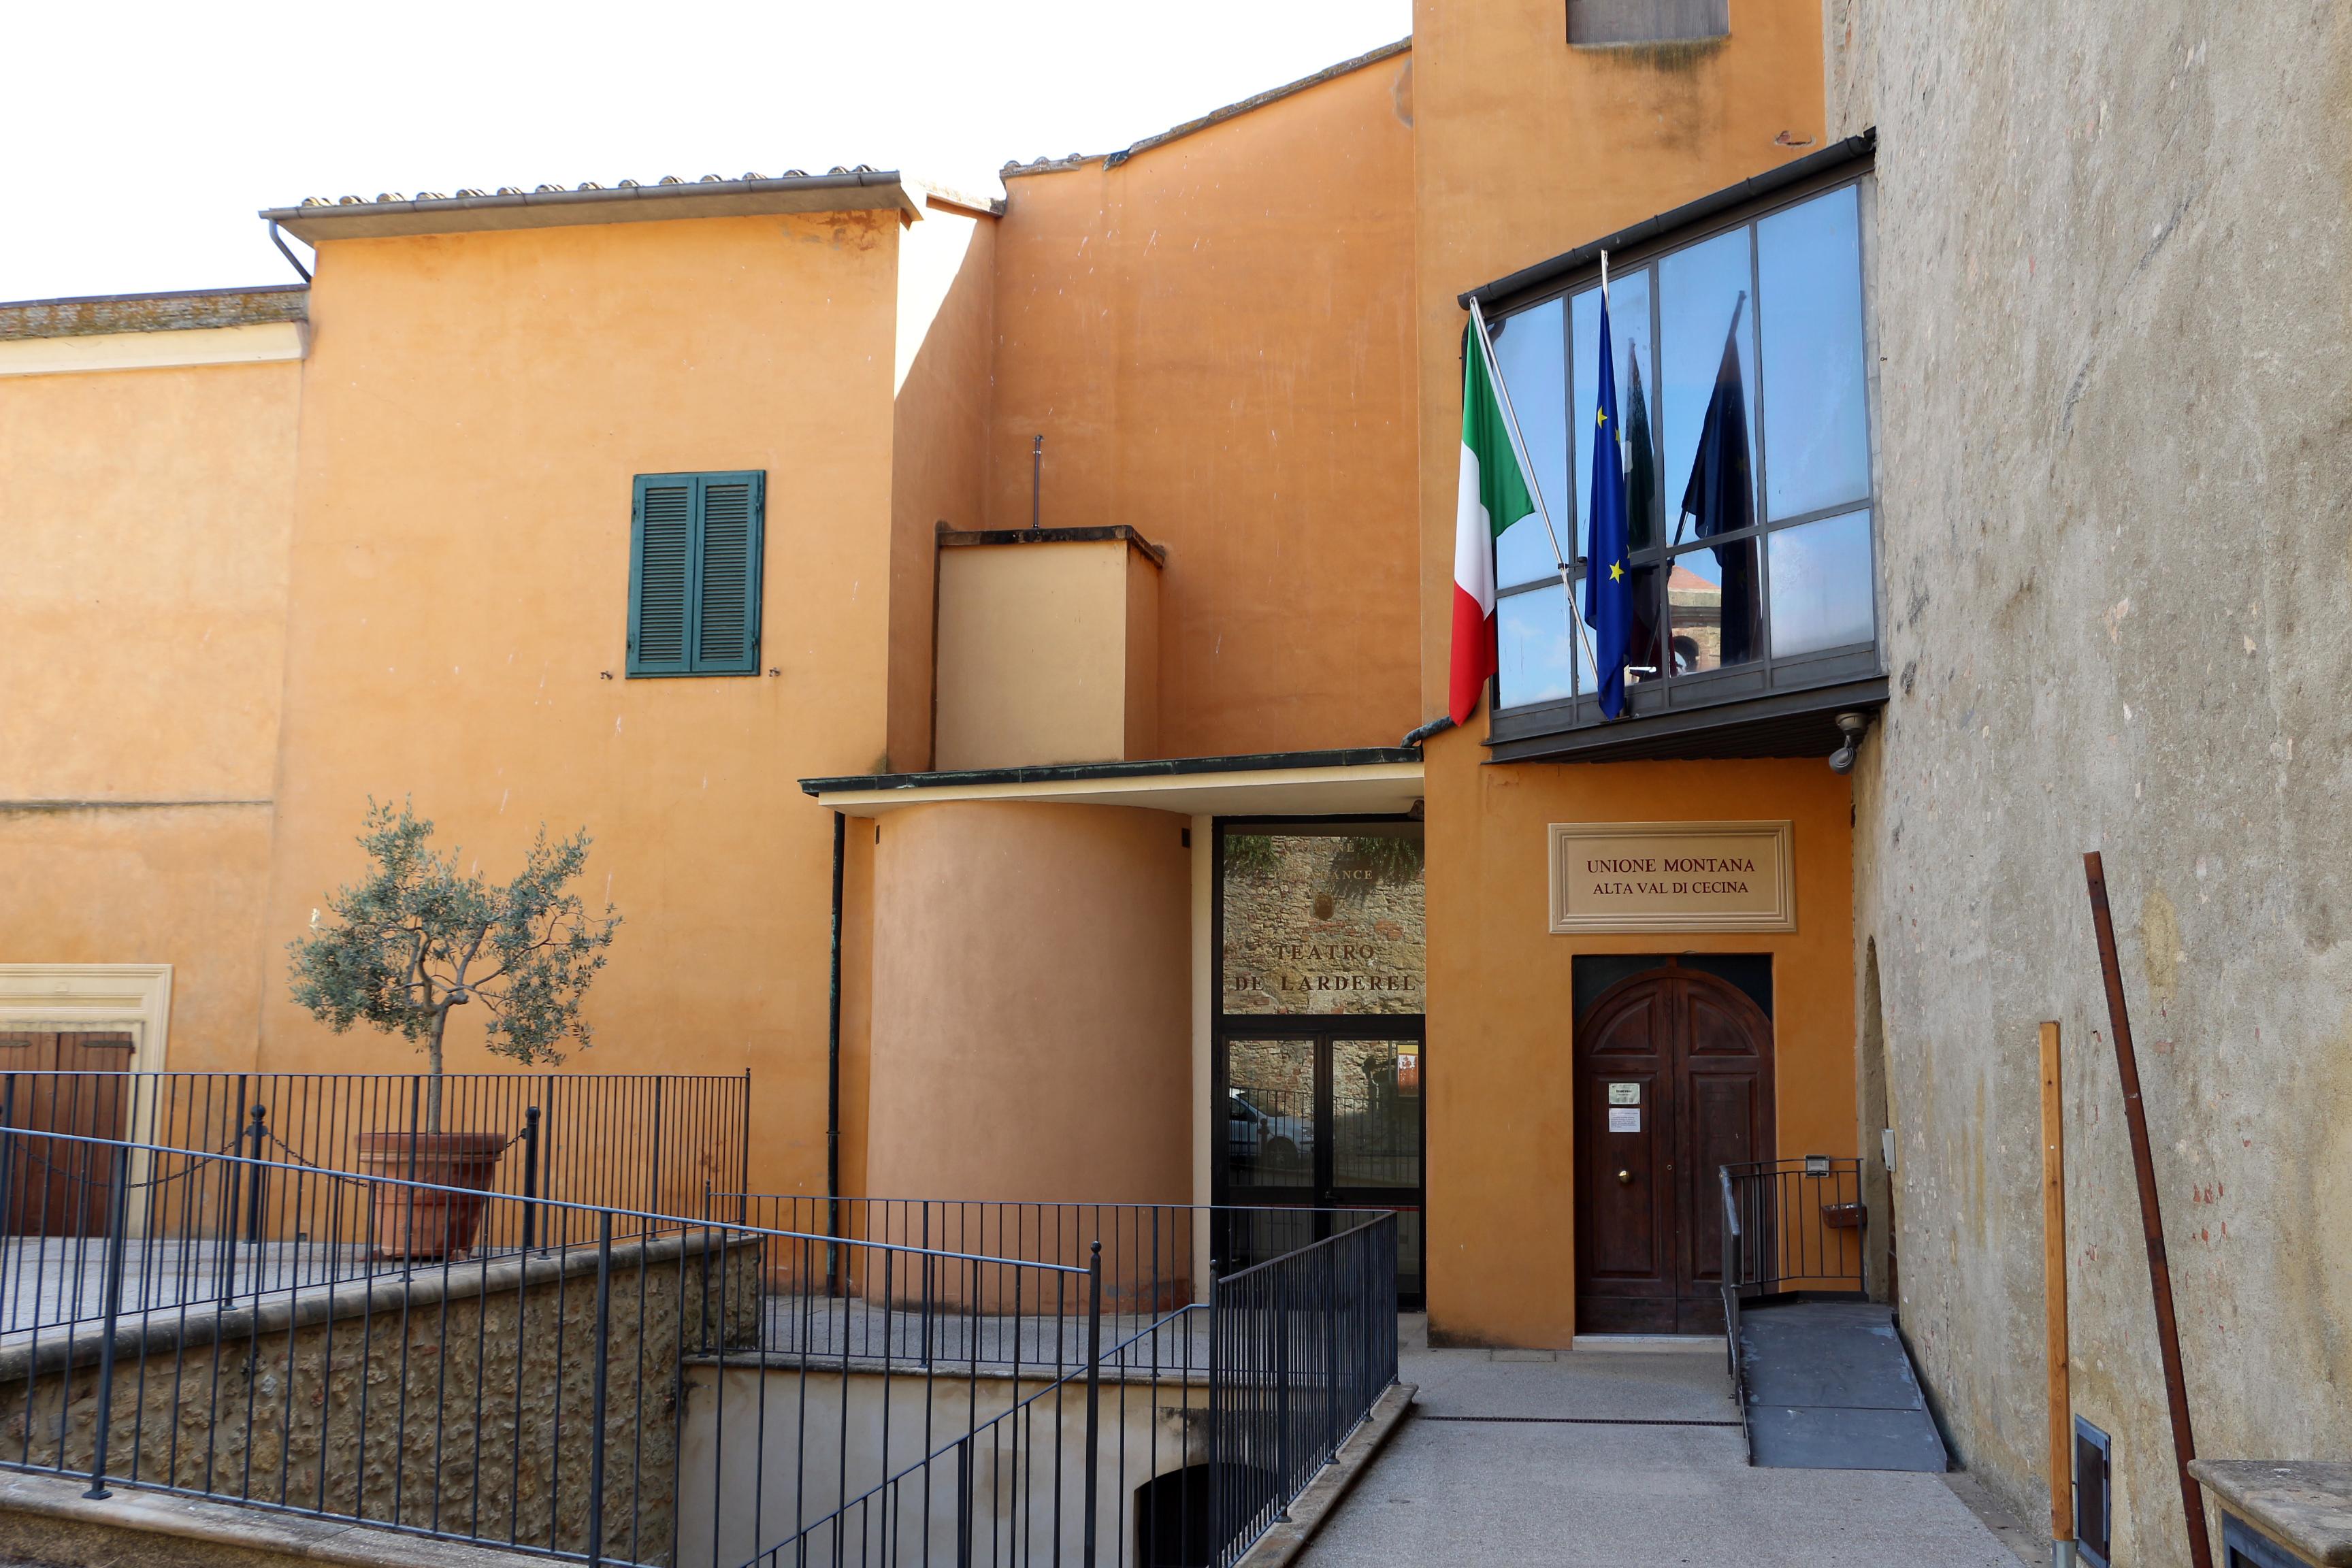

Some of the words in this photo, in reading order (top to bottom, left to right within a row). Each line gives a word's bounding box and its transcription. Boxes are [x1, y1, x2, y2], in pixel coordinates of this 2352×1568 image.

[1587, 859, 1656, 872] UNIONE
[1663, 858, 1755, 872] MONTANA
[1273, 870, 1373, 880] POMARANCE
[1593, 883, 1633, 894] ALTA
[1637, 882, 1668, 894] VAL
[1672, 882, 1688, 894] DI
[1692, 881, 1748, 894] CECINA
[1275, 945, 1374, 960] TEATRO
[1235, 976, 1264, 991] DE
[1281, 975, 1416, 991] LARDEREL
